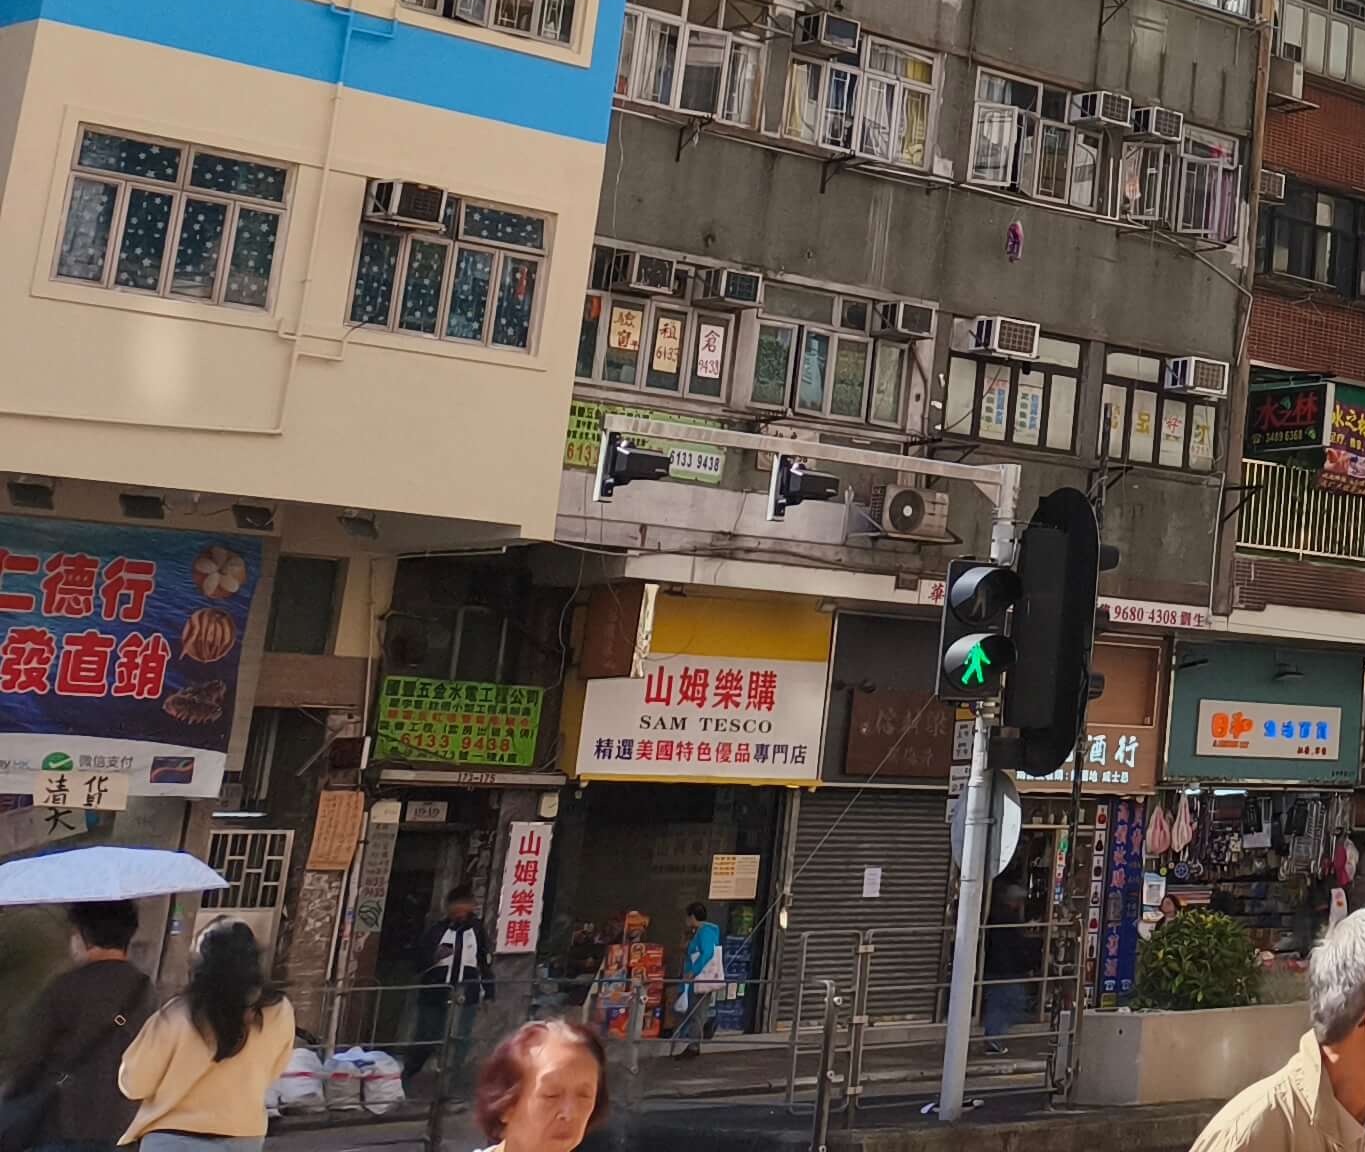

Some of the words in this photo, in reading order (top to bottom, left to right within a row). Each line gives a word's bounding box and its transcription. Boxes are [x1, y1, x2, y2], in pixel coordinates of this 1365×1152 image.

[697, 452, 720, 473] 9438
[1114, 604, 1144, 622] 9680
[1148, 608, 1177, 625] 4308
[644, 665, 778, 713] 山姆樂購
[640, 714, 687, 731] SAM
[699, 716, 773, 734] TESCO
[400, 732, 451, 748] 6133
[462, 736, 512, 752] 9438
[593, 737, 808, 766] 精選美國特色優品專門店
[78, 753, 137, 772] 微信支付
[504, 830, 542, 947] 山姆樂購
